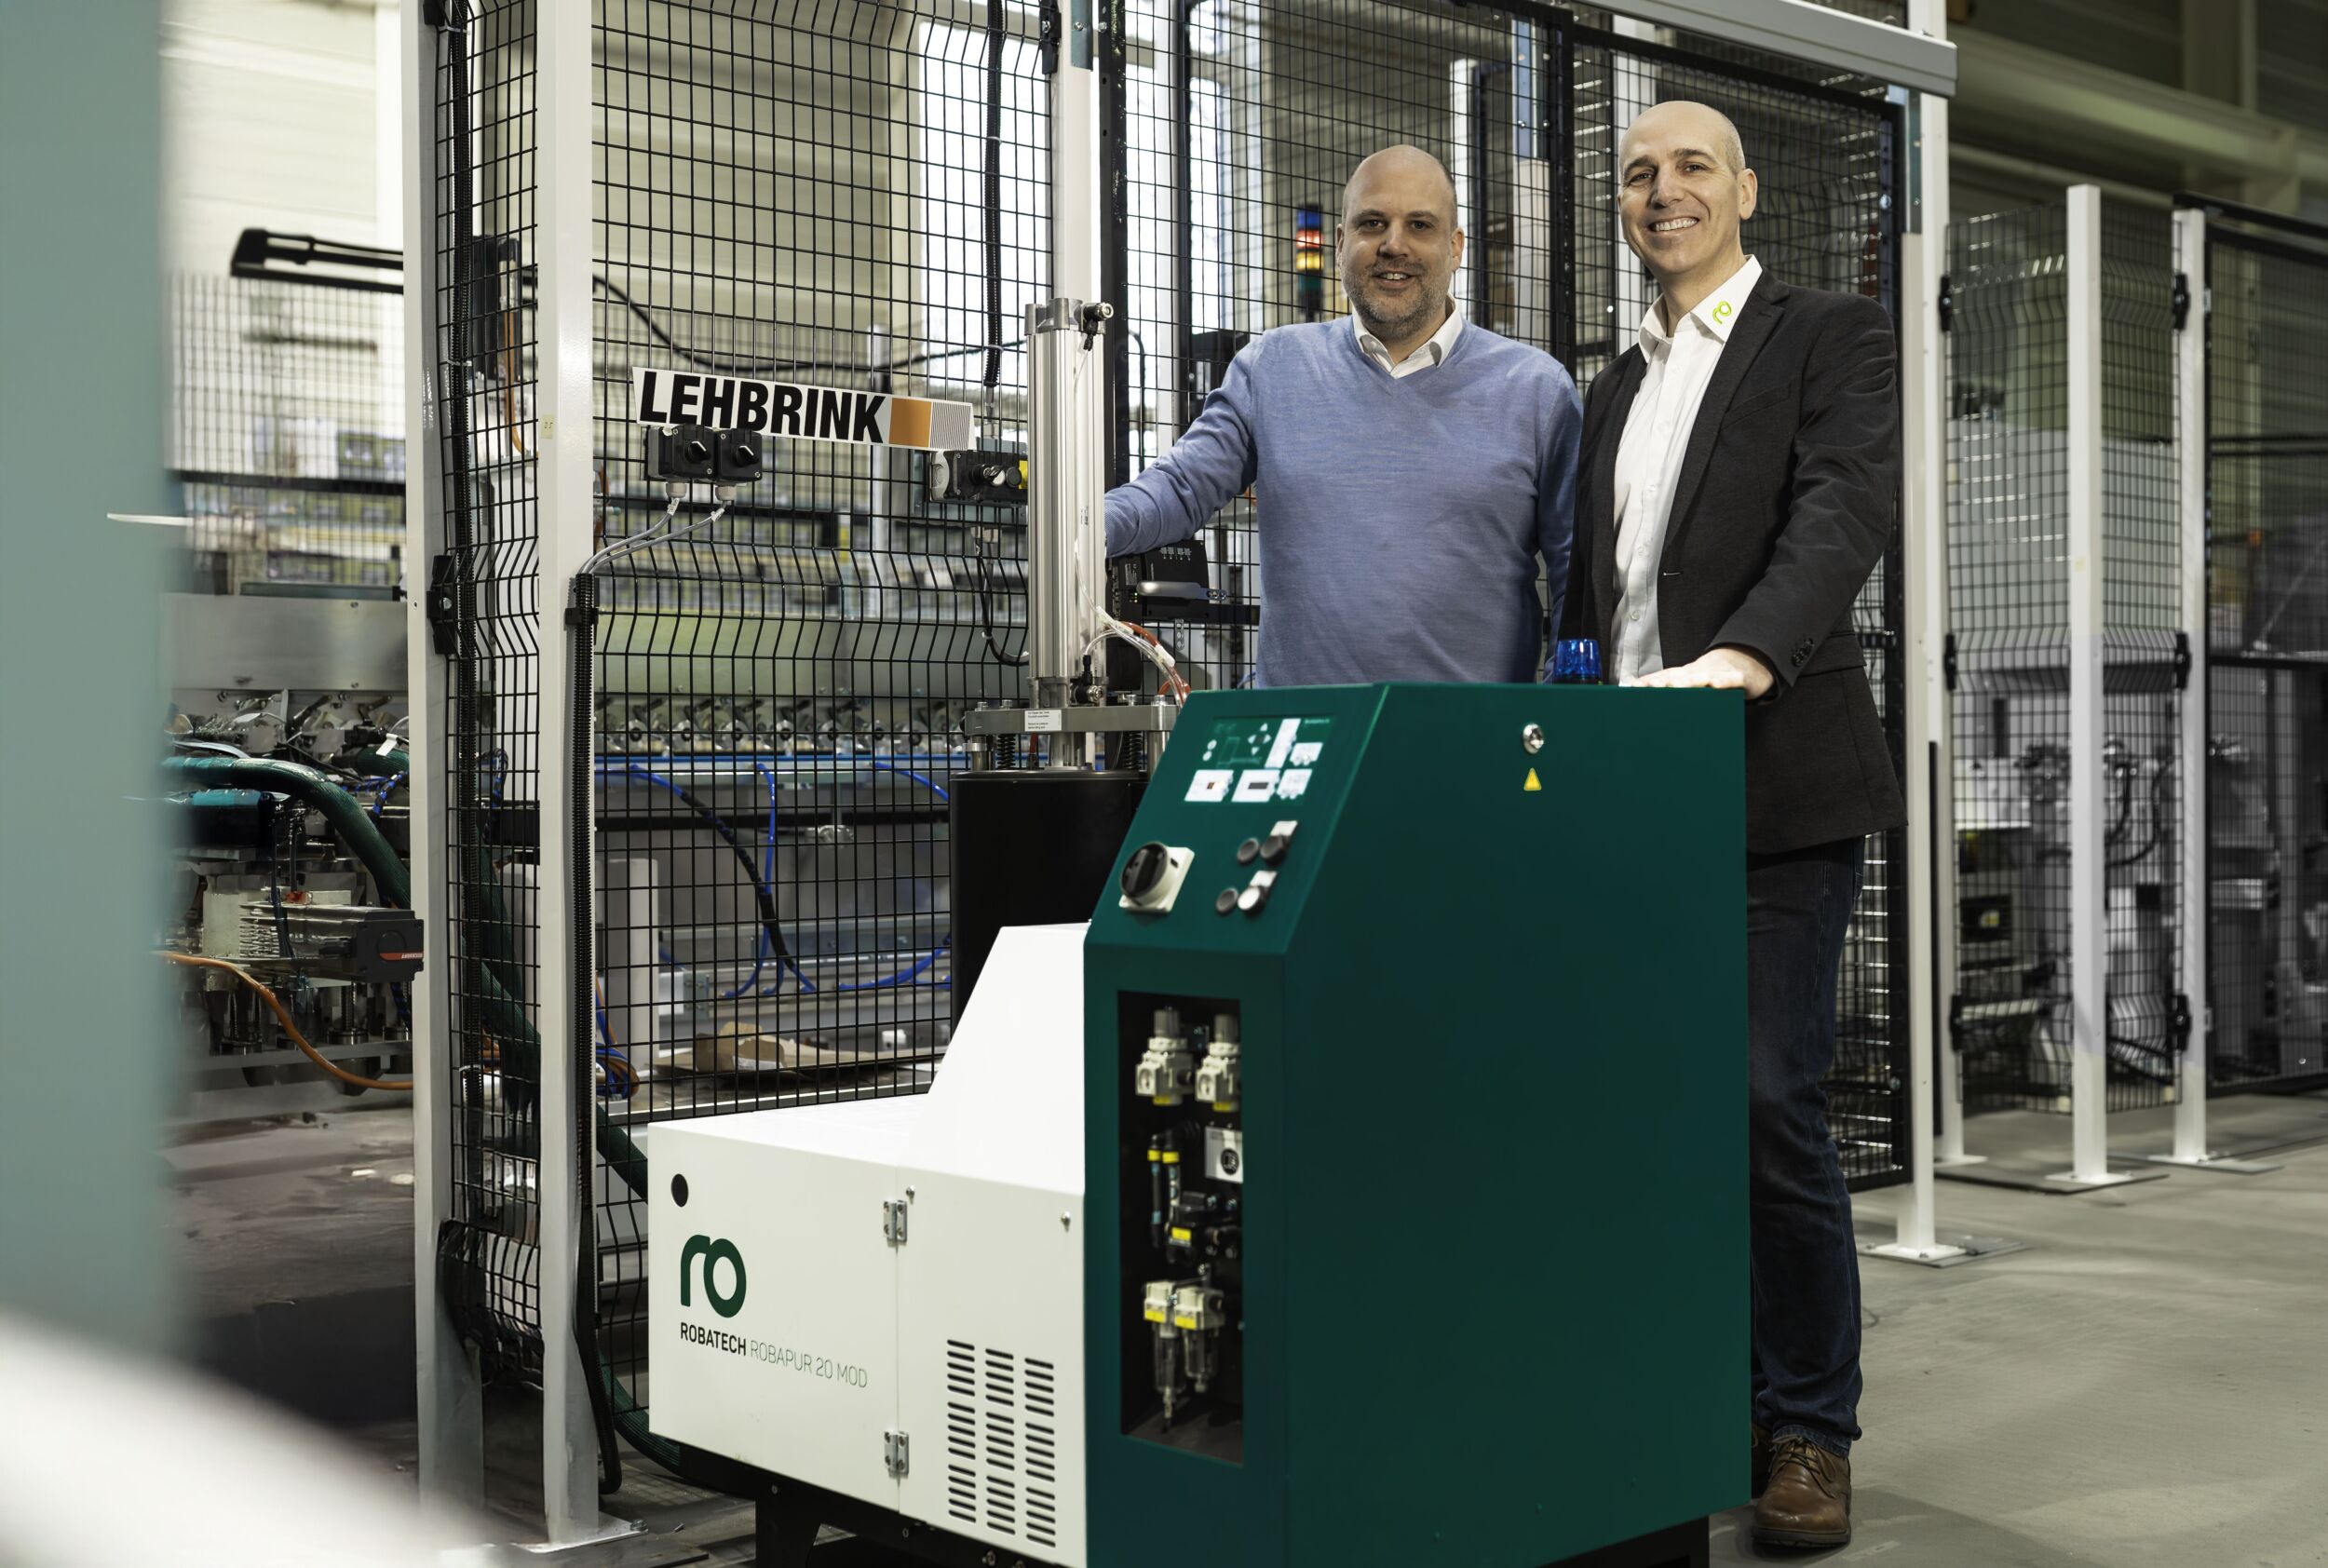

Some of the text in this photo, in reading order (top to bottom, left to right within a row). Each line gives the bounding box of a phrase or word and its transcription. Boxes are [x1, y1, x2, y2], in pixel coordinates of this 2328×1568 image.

[640, 371, 887, 444] LEHBRINK
[681, 1234, 747, 1318] ro
[681, 1322, 868, 1388] ROBATECH ROBAPUR 20 MOD
